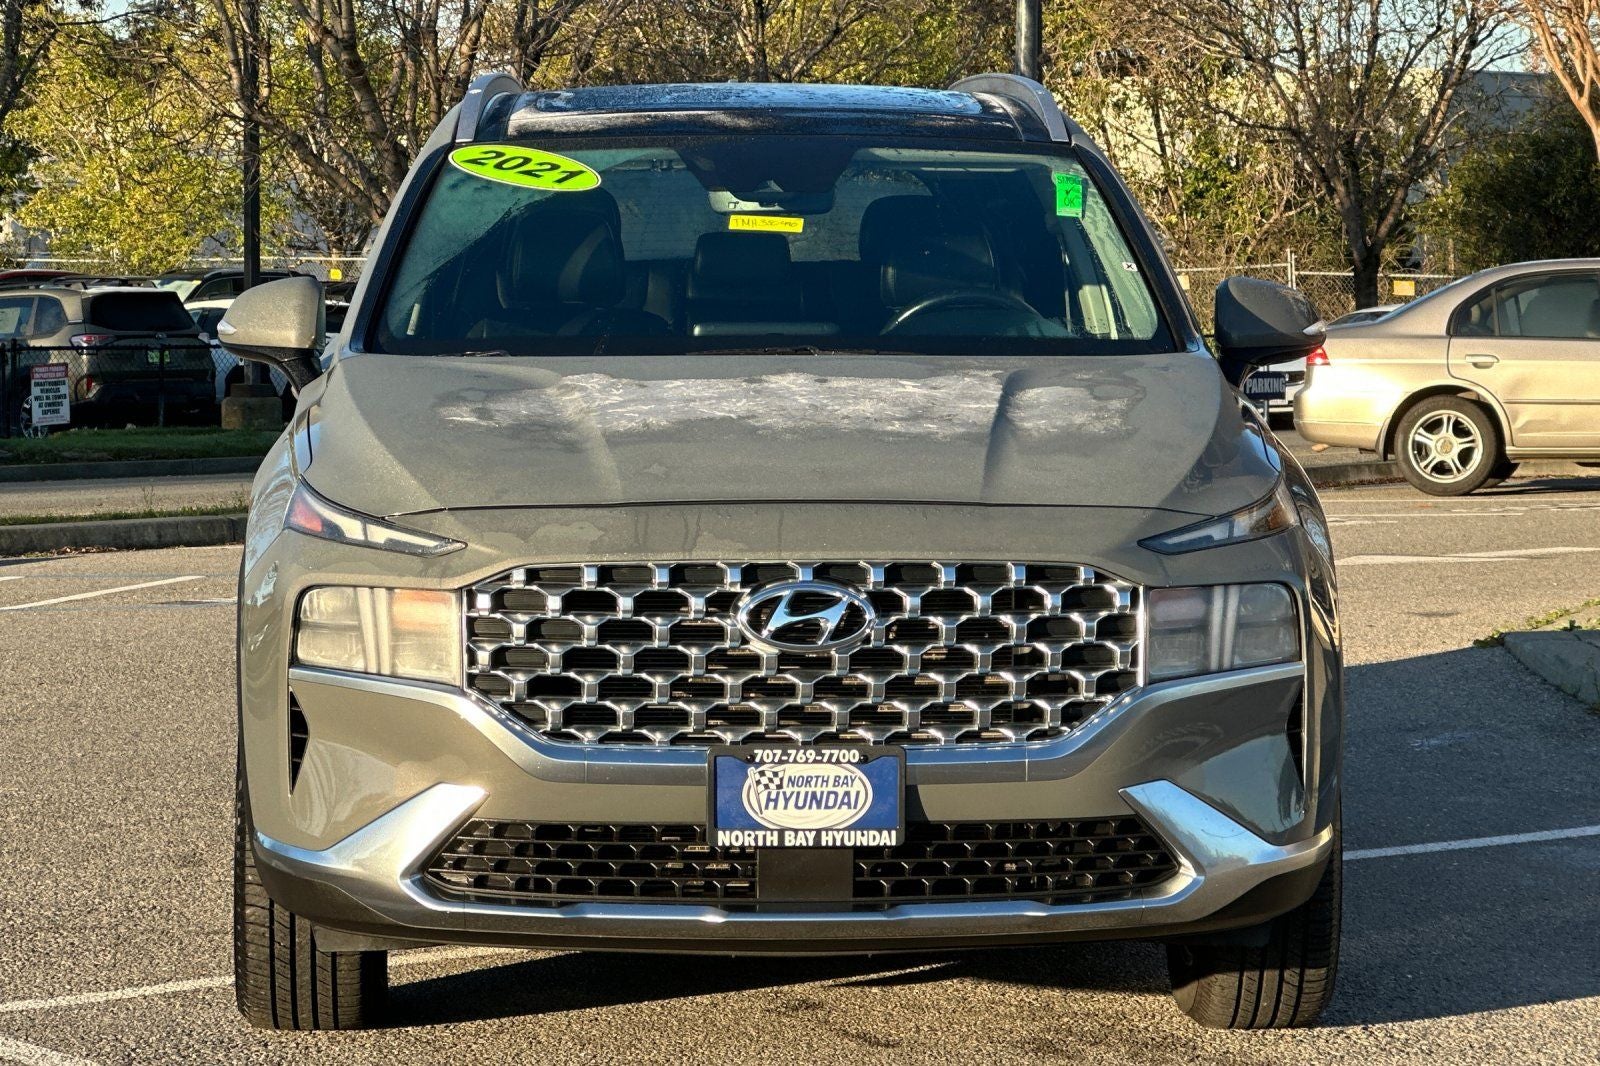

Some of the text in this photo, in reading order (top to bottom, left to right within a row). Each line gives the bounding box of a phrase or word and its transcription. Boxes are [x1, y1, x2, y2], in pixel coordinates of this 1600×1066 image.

[460, 150, 587, 184] 2021
[1057, 175, 1081, 185] SMOG
[1246, 377, 1286, 394] PARKING
[753, 749, 859, 763] 707-769-7700
[786, 774, 858, 788] NORTH BAY
[764, 790, 861, 811] HYUNDAI
[717, 830, 897, 847] NORTH BAY HYUNDAI
